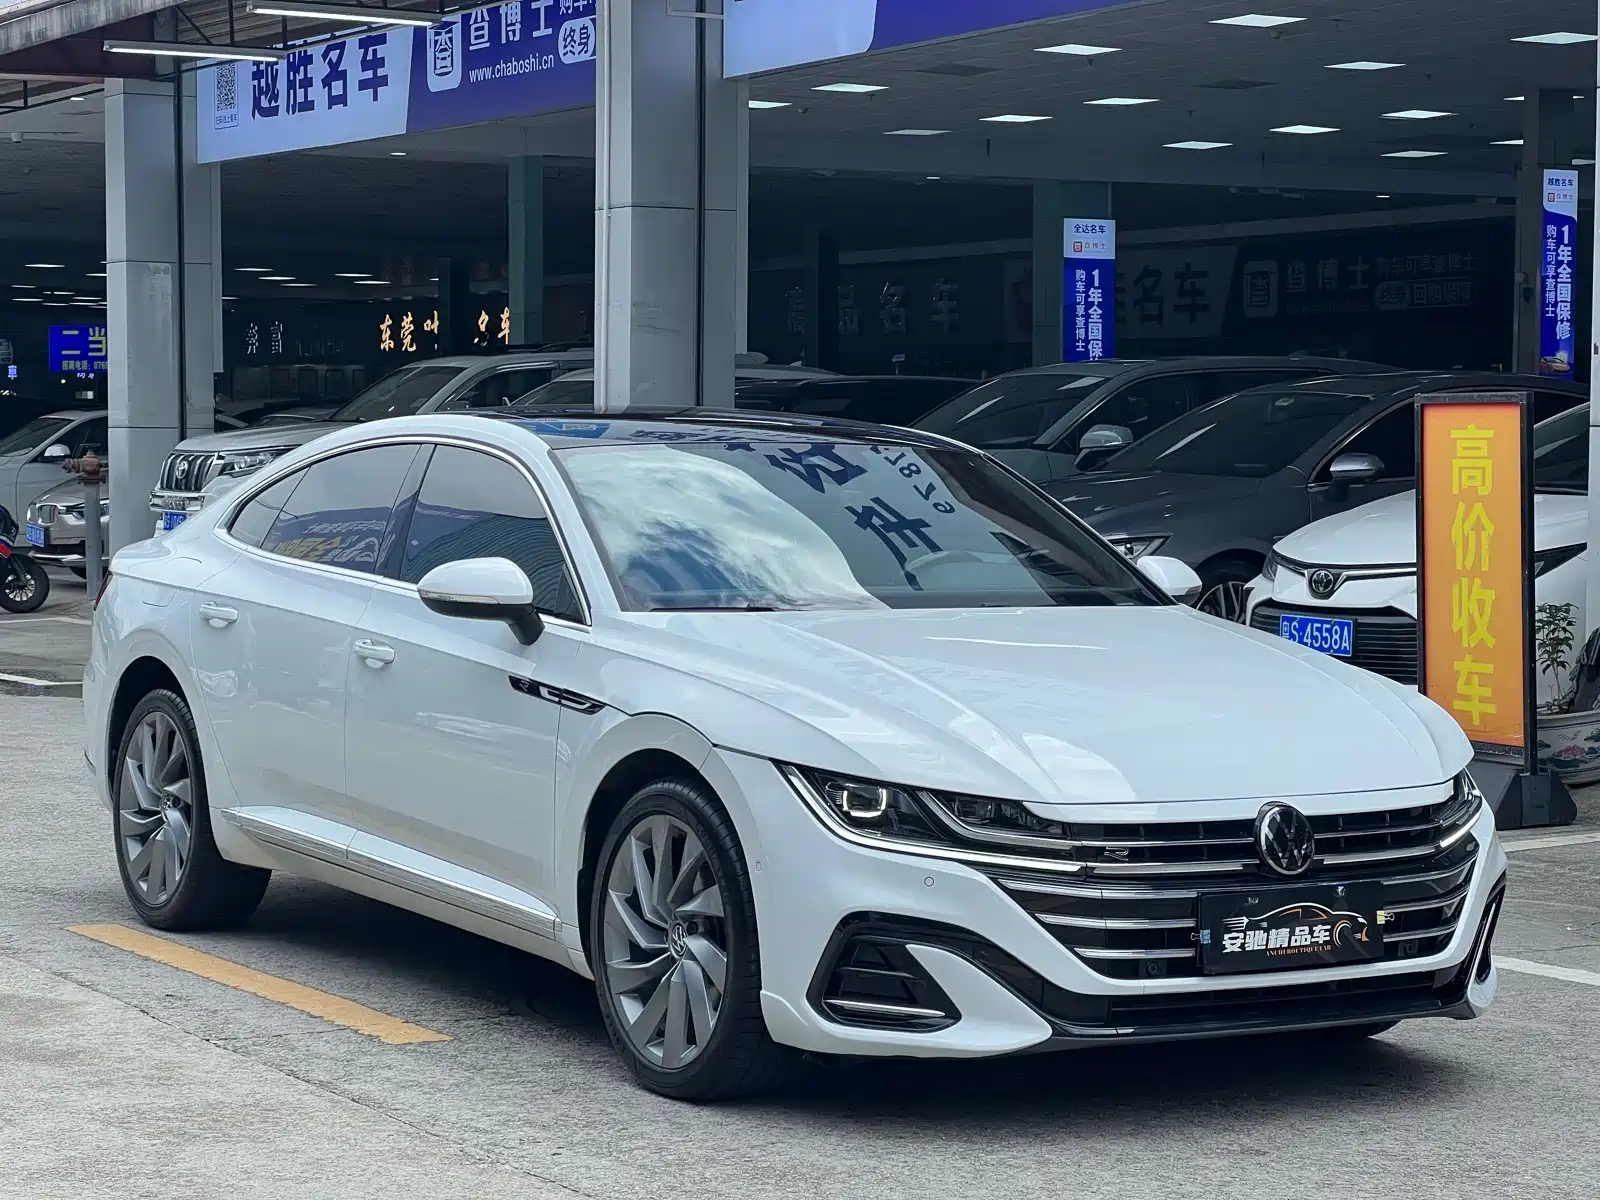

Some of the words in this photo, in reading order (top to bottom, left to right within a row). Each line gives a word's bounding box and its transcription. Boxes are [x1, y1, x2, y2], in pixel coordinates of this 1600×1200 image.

[251, 33, 389, 120] 越胜名车
[469, 53, 554, 83] www.chaboshi.cn
[562, 24, 591, 57] 终身
[1073, 223, 1107, 235] 全达名车
[1545, 225, 1556, 316] 购车可享查博士
[1075, 269, 1086, 351] 购车可享查博士
[1088, 269, 1102, 360] 1年全国保
[1556, 225, 1572, 340] 1年全国保修
[1450, 424, 1496, 725] 高价收车
[1222, 924, 1332, 953] 安驰精品车
